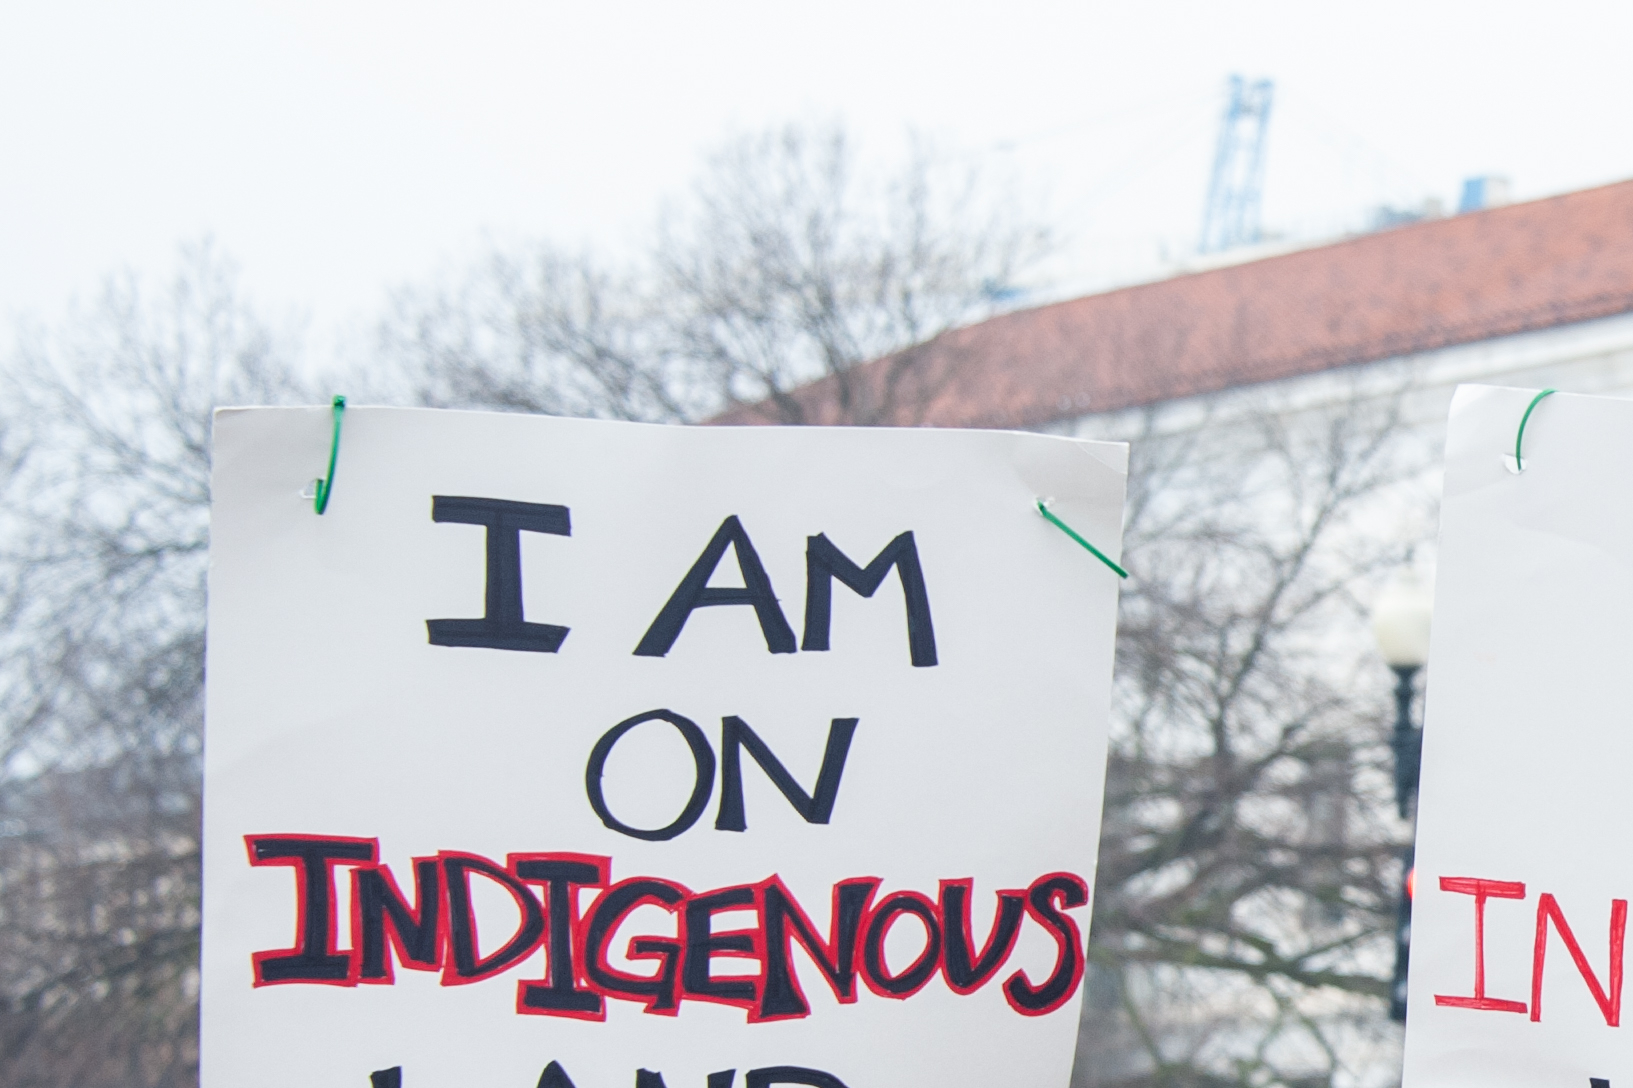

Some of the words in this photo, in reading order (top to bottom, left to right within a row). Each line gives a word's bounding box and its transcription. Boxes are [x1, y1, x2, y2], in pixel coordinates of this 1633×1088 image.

[426, 496, 571, 652] I
[633, 516, 937, 666] AM
[586, 709, 858, 841] ON
[244, 832, 1088, 1023] INDIGENOUS
